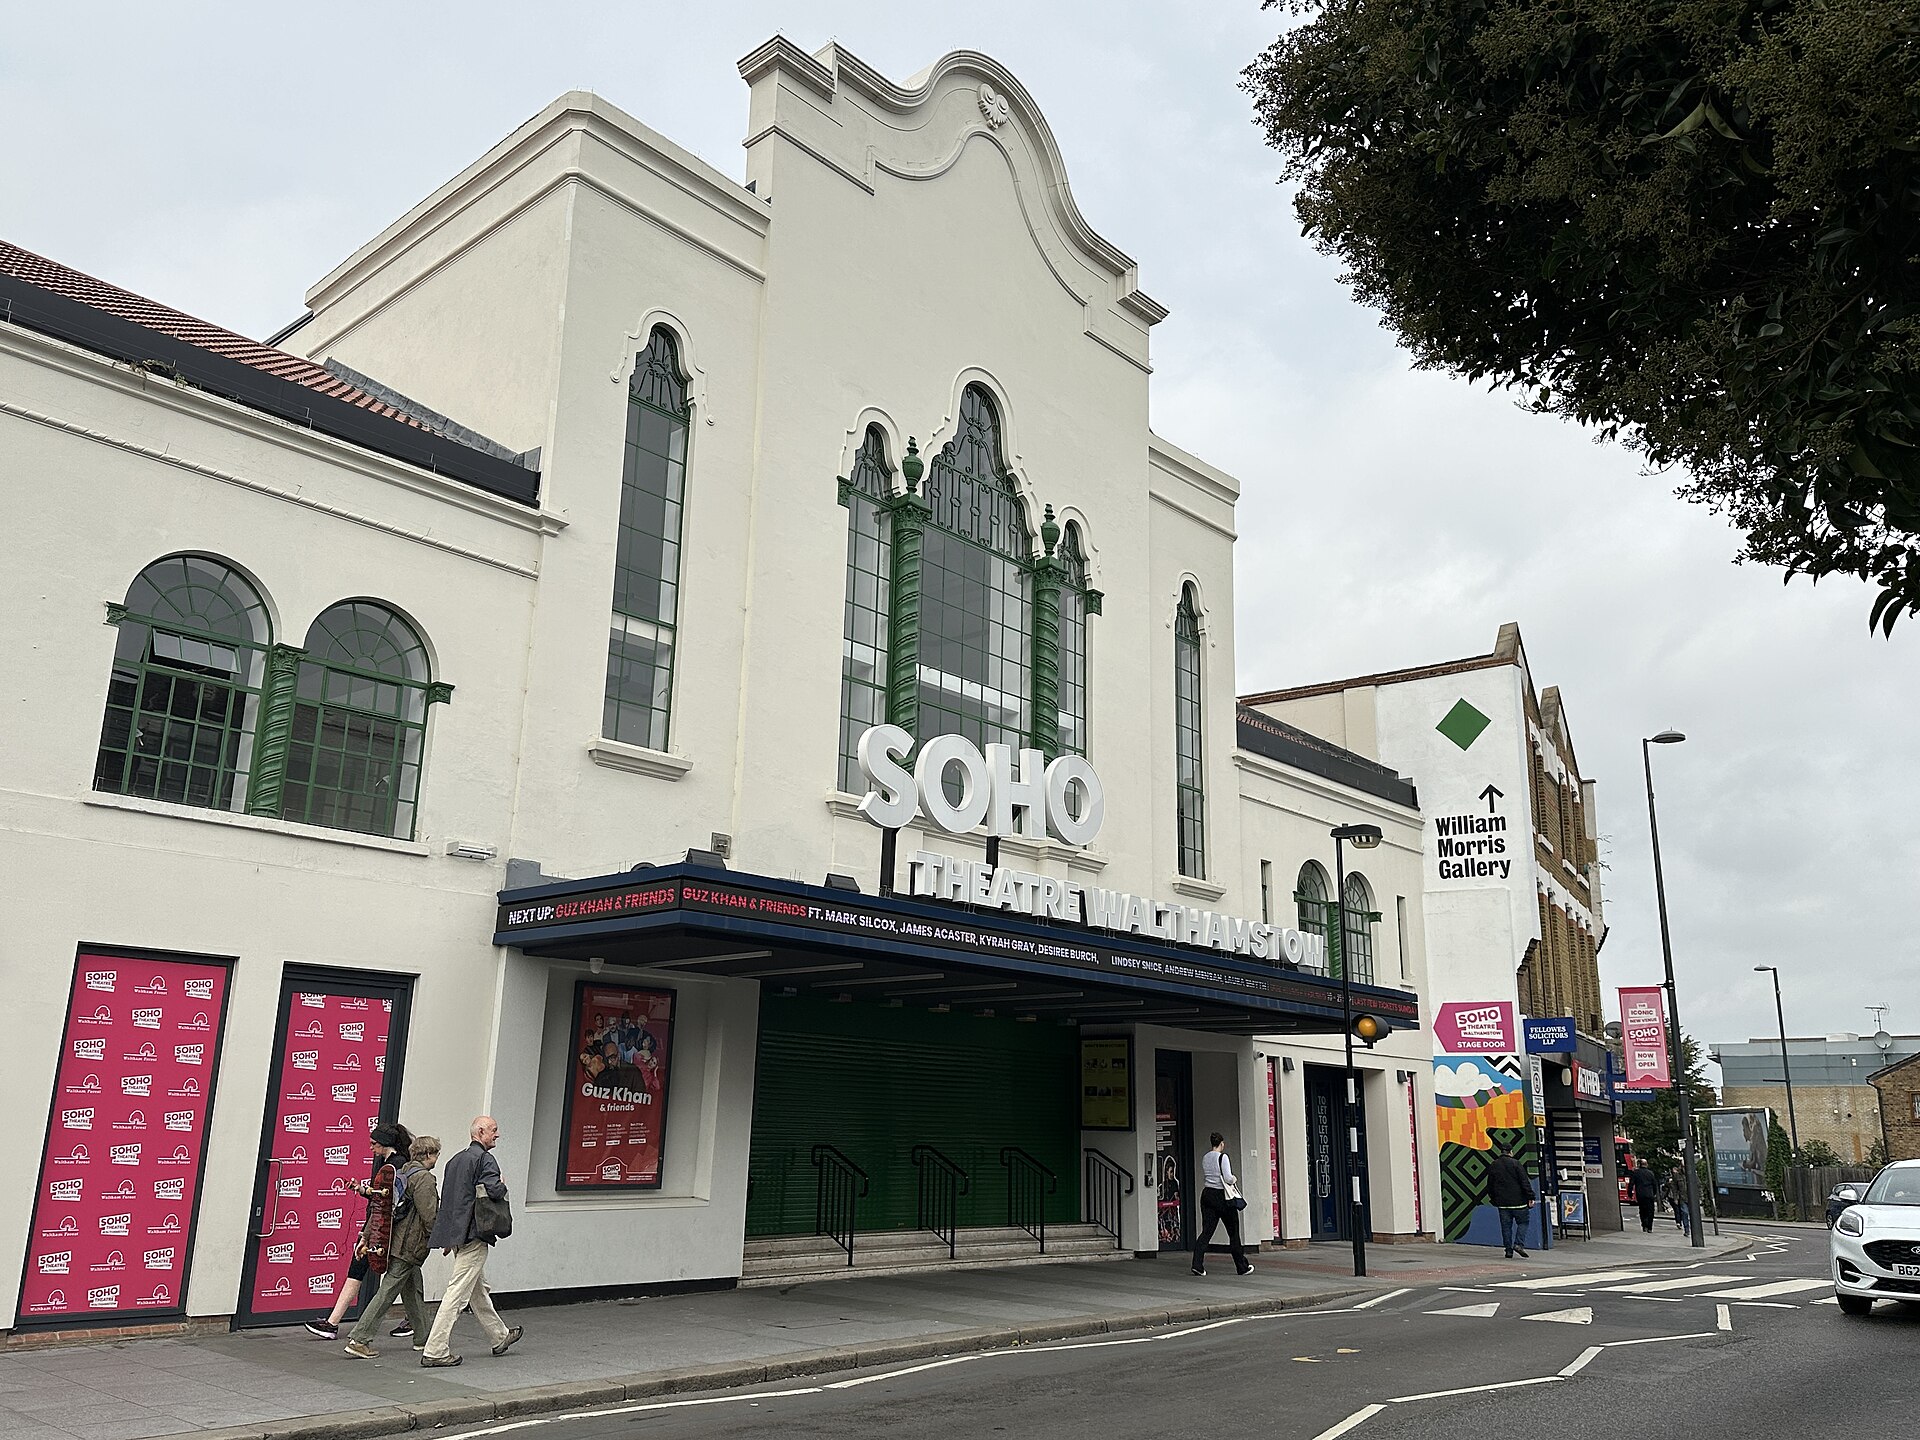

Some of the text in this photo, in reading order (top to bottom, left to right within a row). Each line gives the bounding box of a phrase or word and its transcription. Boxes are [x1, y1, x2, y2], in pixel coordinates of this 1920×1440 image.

[857, 724, 1105, 845] SOHO
[1435, 815, 1506, 836] William
[1438, 835, 1506, 857] Morris
[1439, 858, 1511, 879] Gallery
[509, 888, 675, 925] NEXT UP: GUZ KHAN & FRIENDS
[907, 850, 1324, 967] THEATRE WALTHAMSTOW
[683, 887, 708, 902] GUZ
[711, 891, 746, 908] KHAN
[750, 900, 756, 910] &
[760, 899, 806, 917] FRIENDS
[808, 907, 823, 920] FT.
[826, 910, 858, 926] MARK
[859, 916, 899, 934] SILCOX,
[900, 922, 932, 937] JAMES
[934, 928, 978, 946] ACASTER,
[980, 935, 1010, 949] KYRAH
[1011, 940, 1037, 956] GRAY,
[1038, 945, 1069, 958] DESIREE
[1070, 949, 1099, 964] BURCH,
[1111, 956, 1141, 969] LINDSEY
[1165, 965, 1194, 977] ANDREW
[87, 973, 115, 981] SOHO
[134, 1010, 160, 1018] SOHO
[1458, 1010, 1498, 1024] SOHO
[1630, 1028, 1658, 1038] SOHO
[76, 1040, 104, 1049] SOHO
[176, 1046, 202, 1054] SOHO
[294, 1052, 317, 1060] SOHO
[123, 1077, 150, 1086] SOHO
[333, 1085, 356, 1093] SOHO
[582, 1083, 652, 1105] Guz Khan
[1318, 1096, 1326, 1105] TO
[607, 1103, 634, 1111] friends
[1318, 1105, 1327, 1115] LET
[64, 1110, 92, 1119] SOHO
[166, 1112, 192, 1121] SOHO
[285, 1115, 309, 1123] SOHO
[1319, 1115, 1327, 1124] TO
[1319, 1125, 1328, 1134] LET
[1320, 1135, 1328, 1144] TO
[112, 1145, 139, 1155] SOHO
[326, 1147, 348, 1156] SOHO
[1320, 1145, 1330, 1154] LET
[52, 1181, 81, 1191] SOHO
[156, 1180, 183, 1189] SOHO
[318, 1210, 341, 1219] SOHO
[101, 1215, 129, 1225] SOHO
[269, 1244, 293, 1254] SOHO
[40, 1253, 69, 1264] SOHO
[146, 1249, 172, 1260] SOHO
[310, 1275, 333, 1285] SOHO
[90, 1287, 118, 1298] SOHO
